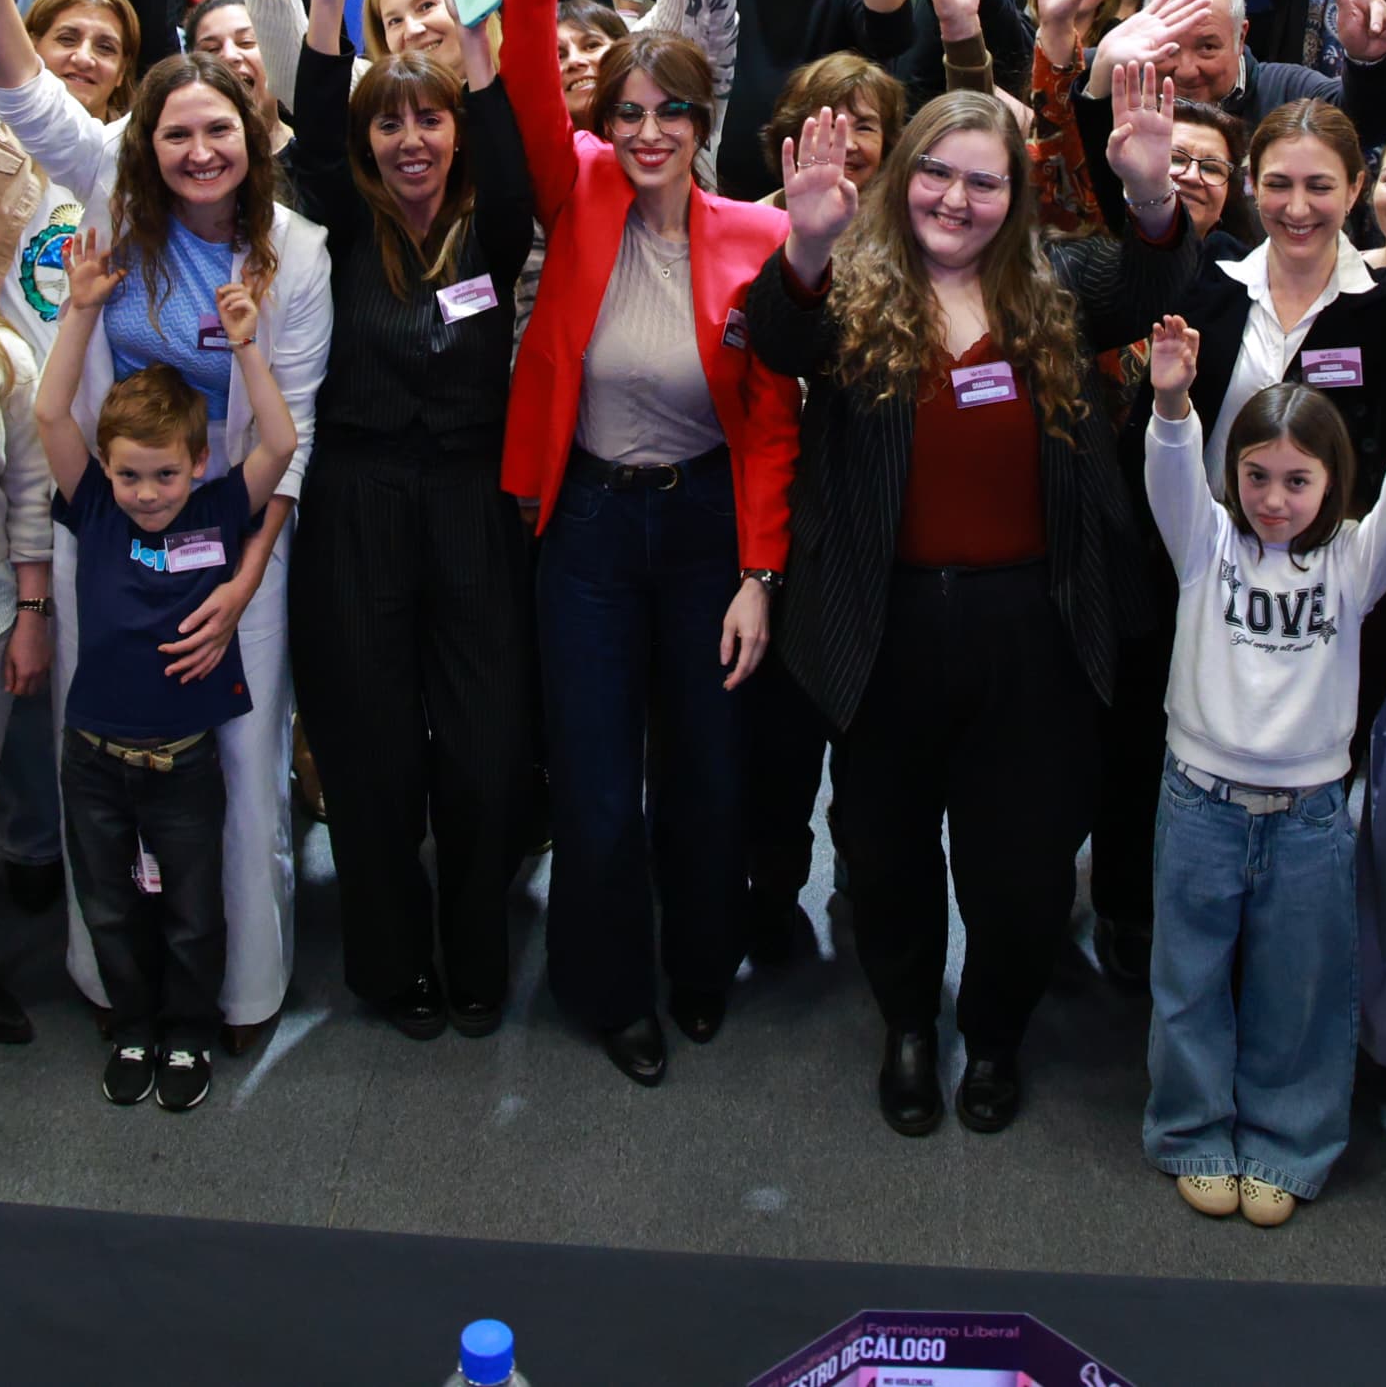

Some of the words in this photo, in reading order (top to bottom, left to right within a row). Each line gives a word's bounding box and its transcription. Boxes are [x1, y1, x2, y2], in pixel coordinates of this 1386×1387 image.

[971, 379, 995, 390] ORADORA
[1224, 583, 1327, 638] LOVE
[866, 1322, 959, 1337] Feminismo
[964, 1325, 1020, 1338] Liberal
[788, 1355, 838, 1387] STRO
[840, 1333, 946, 1371] DECÁLOGO
